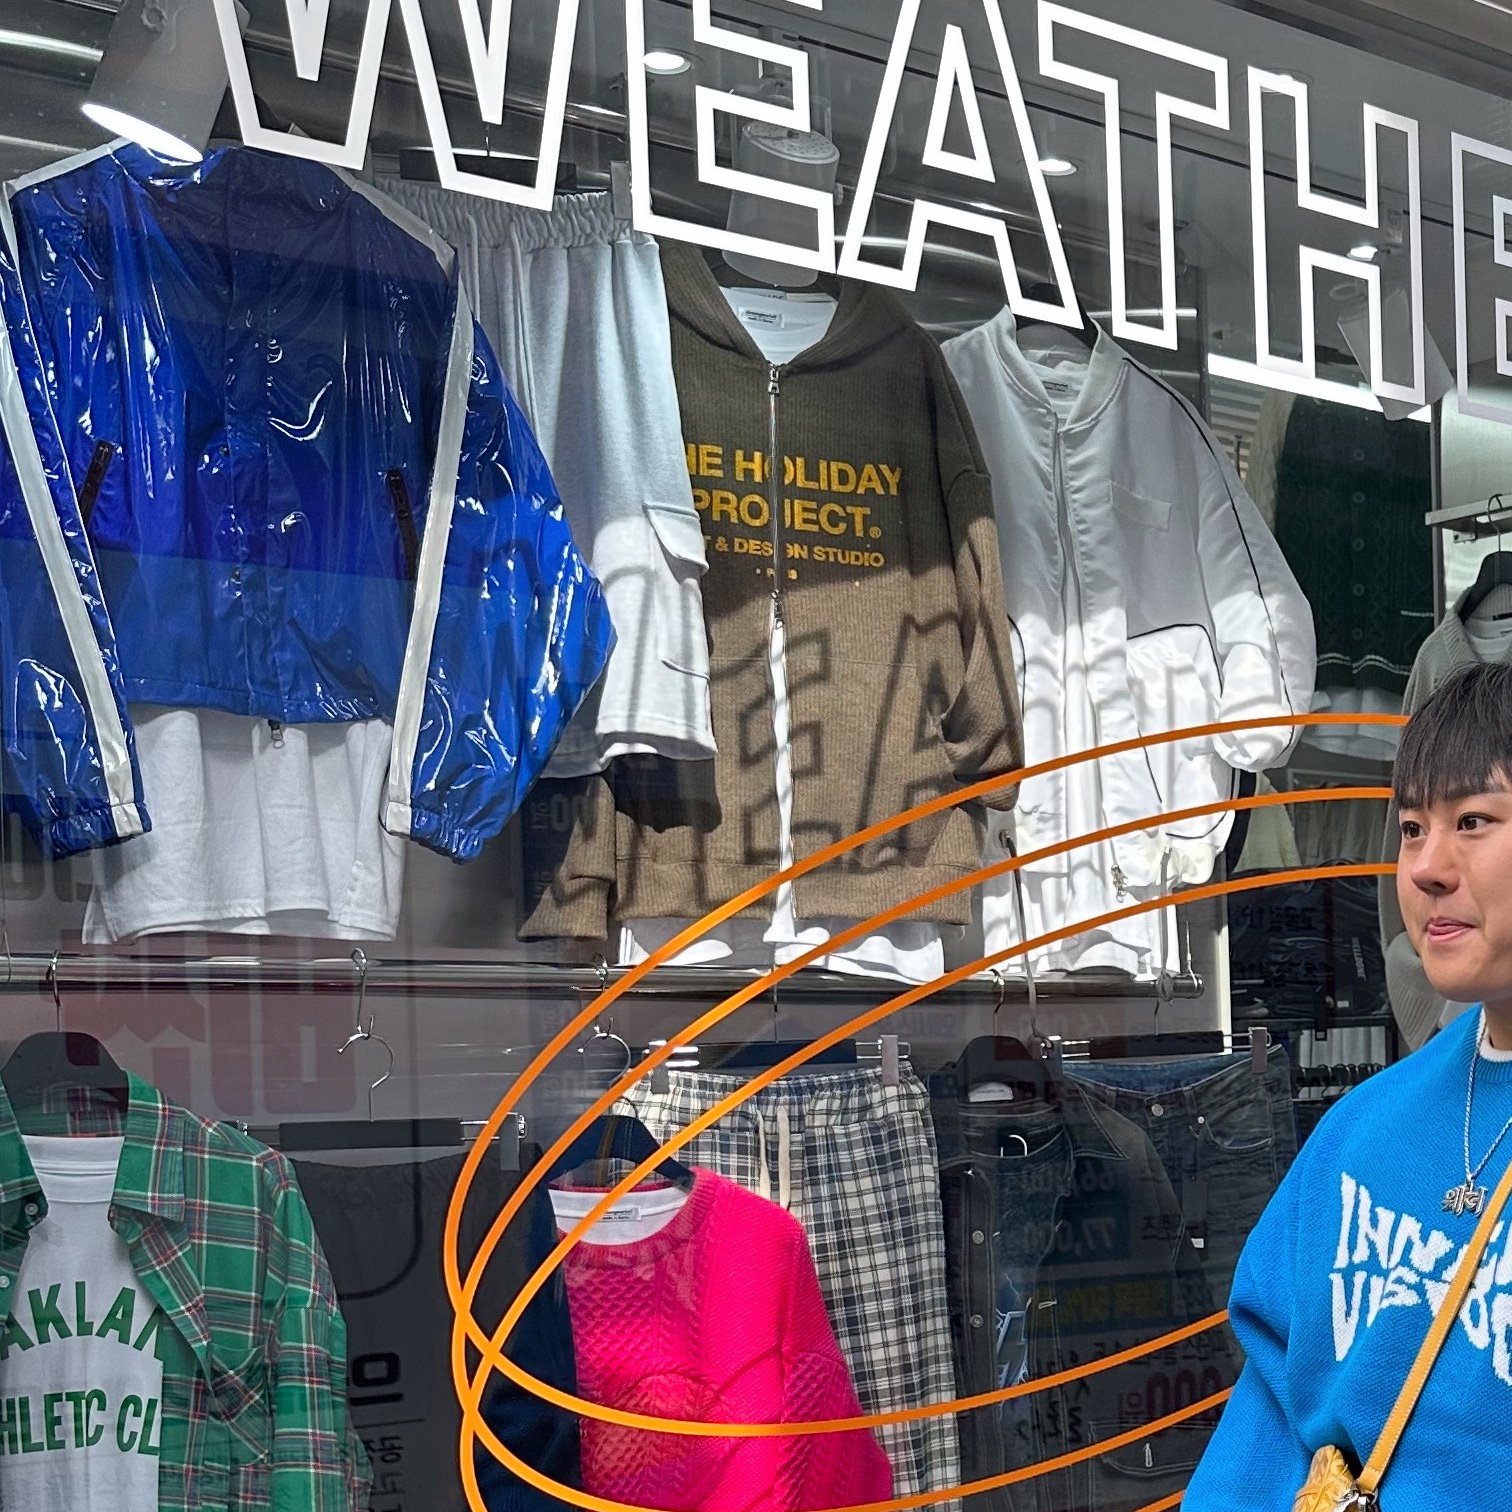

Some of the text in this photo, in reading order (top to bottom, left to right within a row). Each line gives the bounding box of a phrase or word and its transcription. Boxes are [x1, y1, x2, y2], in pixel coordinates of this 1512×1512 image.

[686, 443, 902, 496] HE HOLIDAY
[813, 545, 885, 567] STUDIO
